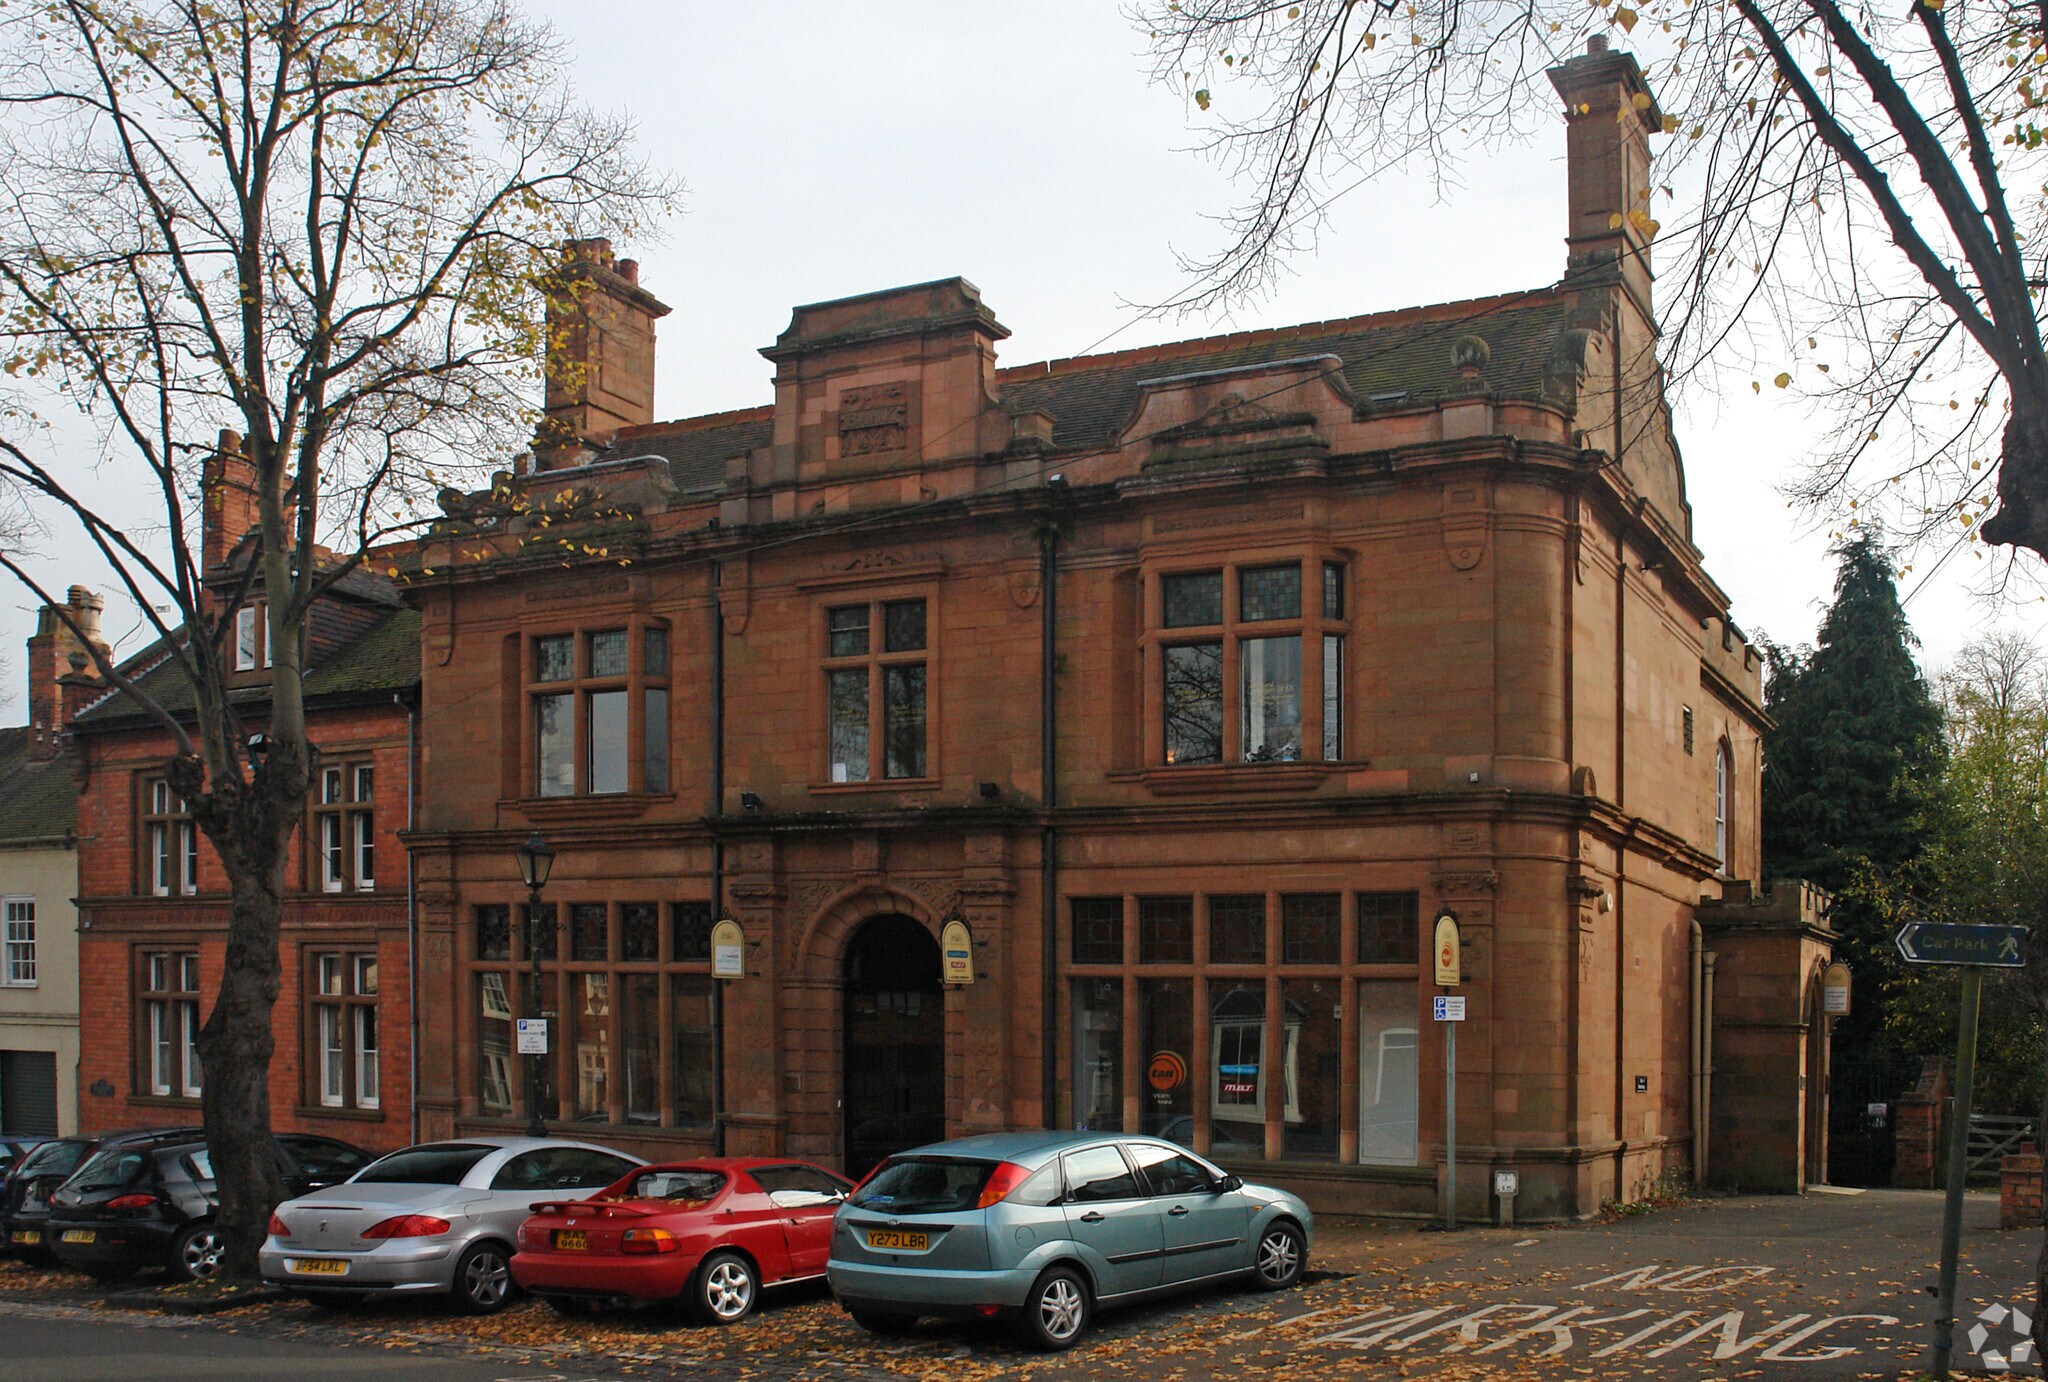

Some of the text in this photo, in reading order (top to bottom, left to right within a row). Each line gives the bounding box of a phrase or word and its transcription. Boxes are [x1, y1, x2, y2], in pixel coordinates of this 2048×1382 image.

[1921, 935, 1989, 952] Car Park
[869, 1232, 926, 1248] Y273 LBR
[1572, 1264, 1777, 1292] NO
[1230, 1303, 1900, 1362] PARKING
